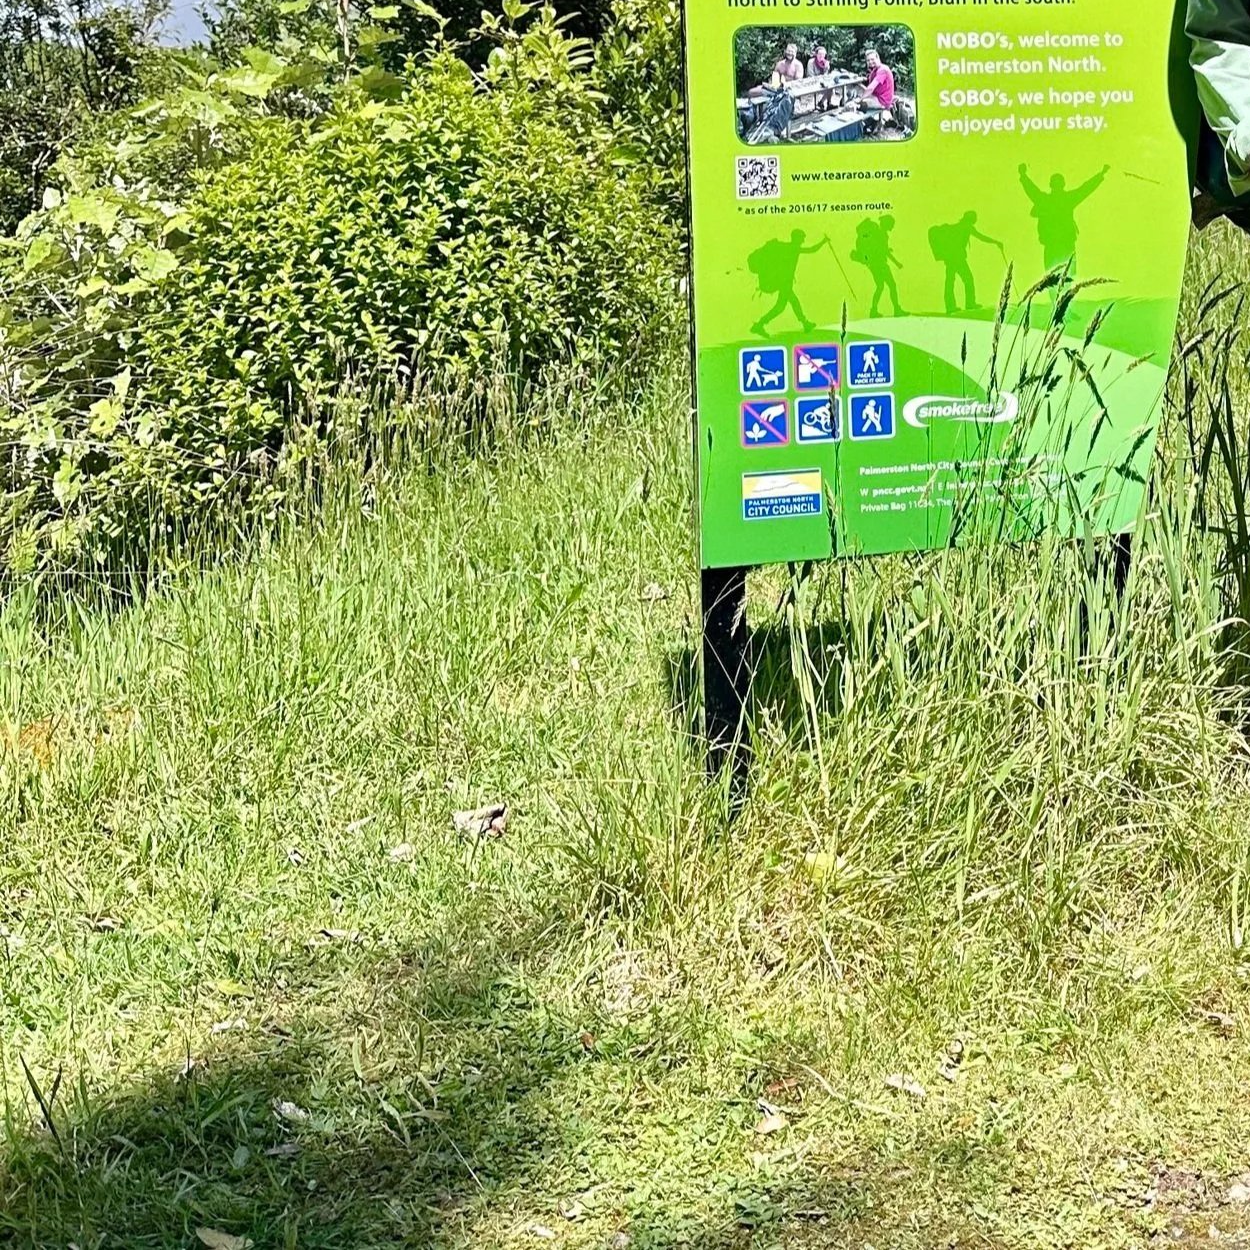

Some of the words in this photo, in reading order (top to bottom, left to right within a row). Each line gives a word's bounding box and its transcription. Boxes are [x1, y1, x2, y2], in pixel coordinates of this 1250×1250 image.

[1017, 31, 1101, 48] welcome
[1105, 33, 1123, 47] to
[938, 57, 1043, 75] Palmerston
[1048, 55, 1107, 73] North.
[1017, 91, 1045, 106] we
[1049, 88, 1096, 109] hope
[1100, 90, 1134, 109] you
[940, 114, 1015, 136] enjoyed
[1020, 116, 1063, 136] your
[1067, 113, 1108, 133] stay.
[791, 169, 910, 182] www.teararoa.org.nz
[758, 205, 769, 214] of
[770, 204, 786, 214] the
[789, 203, 827, 213] 2016/17
[830, 203, 863, 212] season
[865, 202, 894, 211] route.
[859, 465, 909, 476] Palmerston
[910, 462, 936, 471] North
[937, 460, 955, 471] City
[860, 488, 869, 497] W
[749, 498, 791, 506] PALMERSTON
[861, 503, 889, 512] Private
[890, 501, 906, 512] Bag
[748, 506, 770, 516] CITY
[772, 503, 817, 515] COUNCIL
